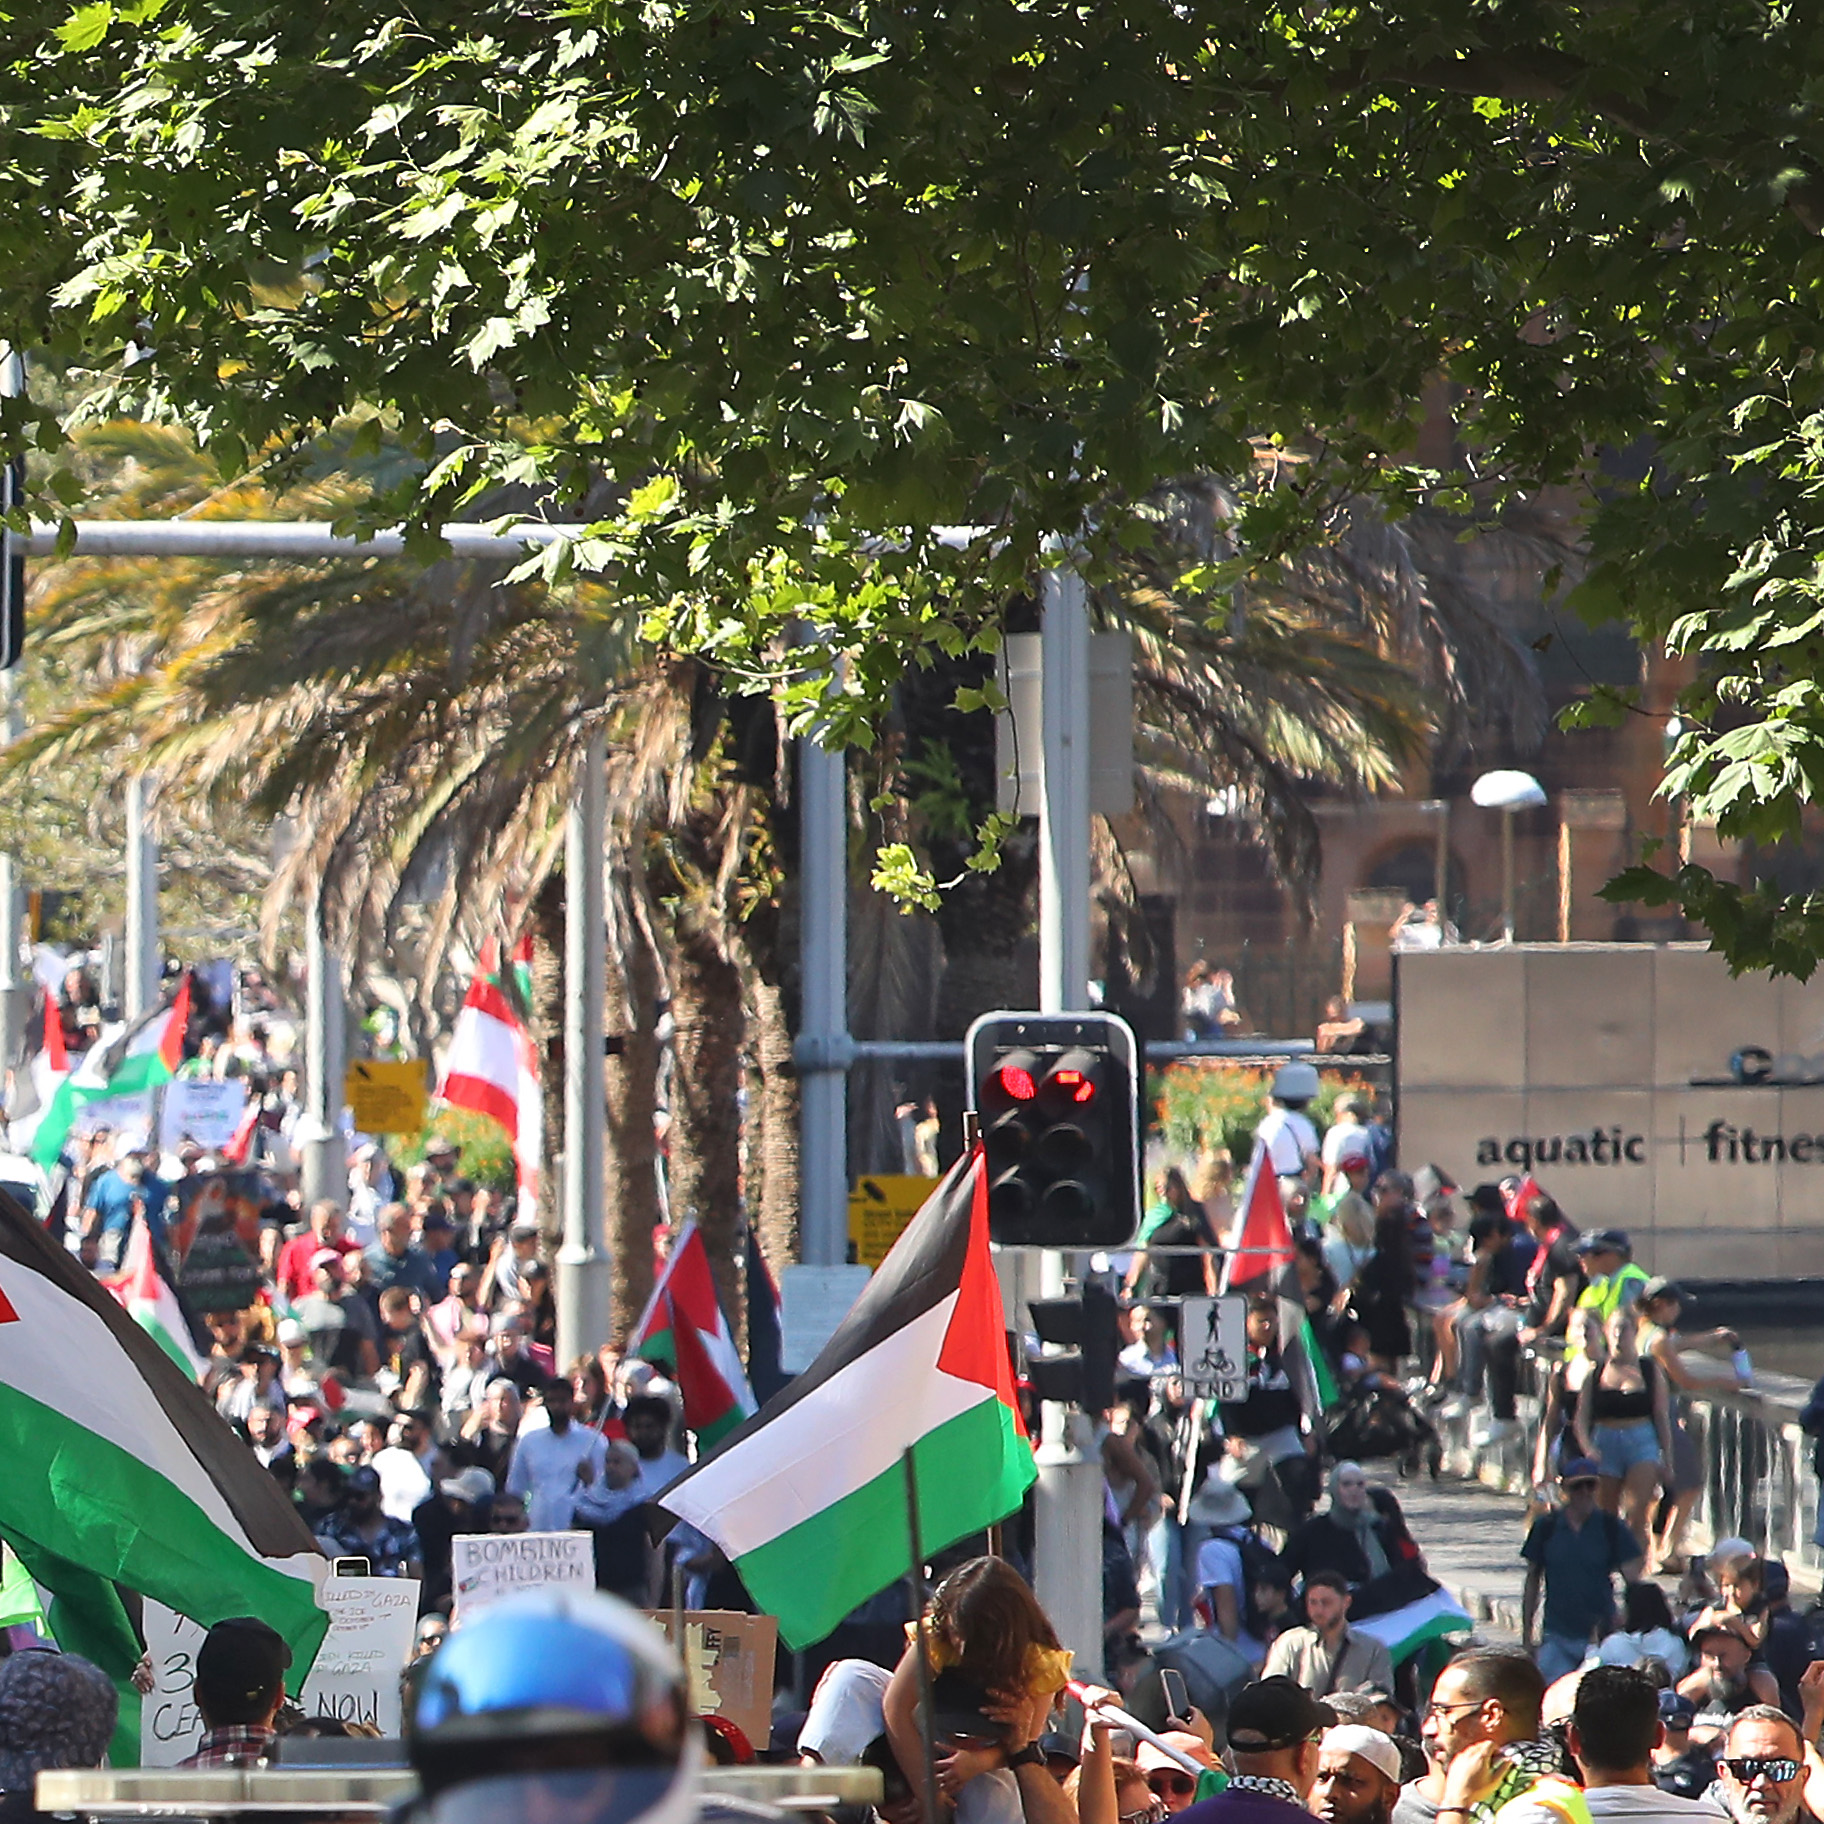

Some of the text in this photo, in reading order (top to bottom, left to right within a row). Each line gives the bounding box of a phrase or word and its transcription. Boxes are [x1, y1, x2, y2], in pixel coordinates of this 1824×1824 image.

[1476, 1127, 1646, 1172] aquatic
[1195, 1381, 1234, 1399] END
[466, 1538, 577, 1567] BOMBING
[478, 1561, 584, 1582] CHILDREN
[318, 1689, 380, 1726] NOW
